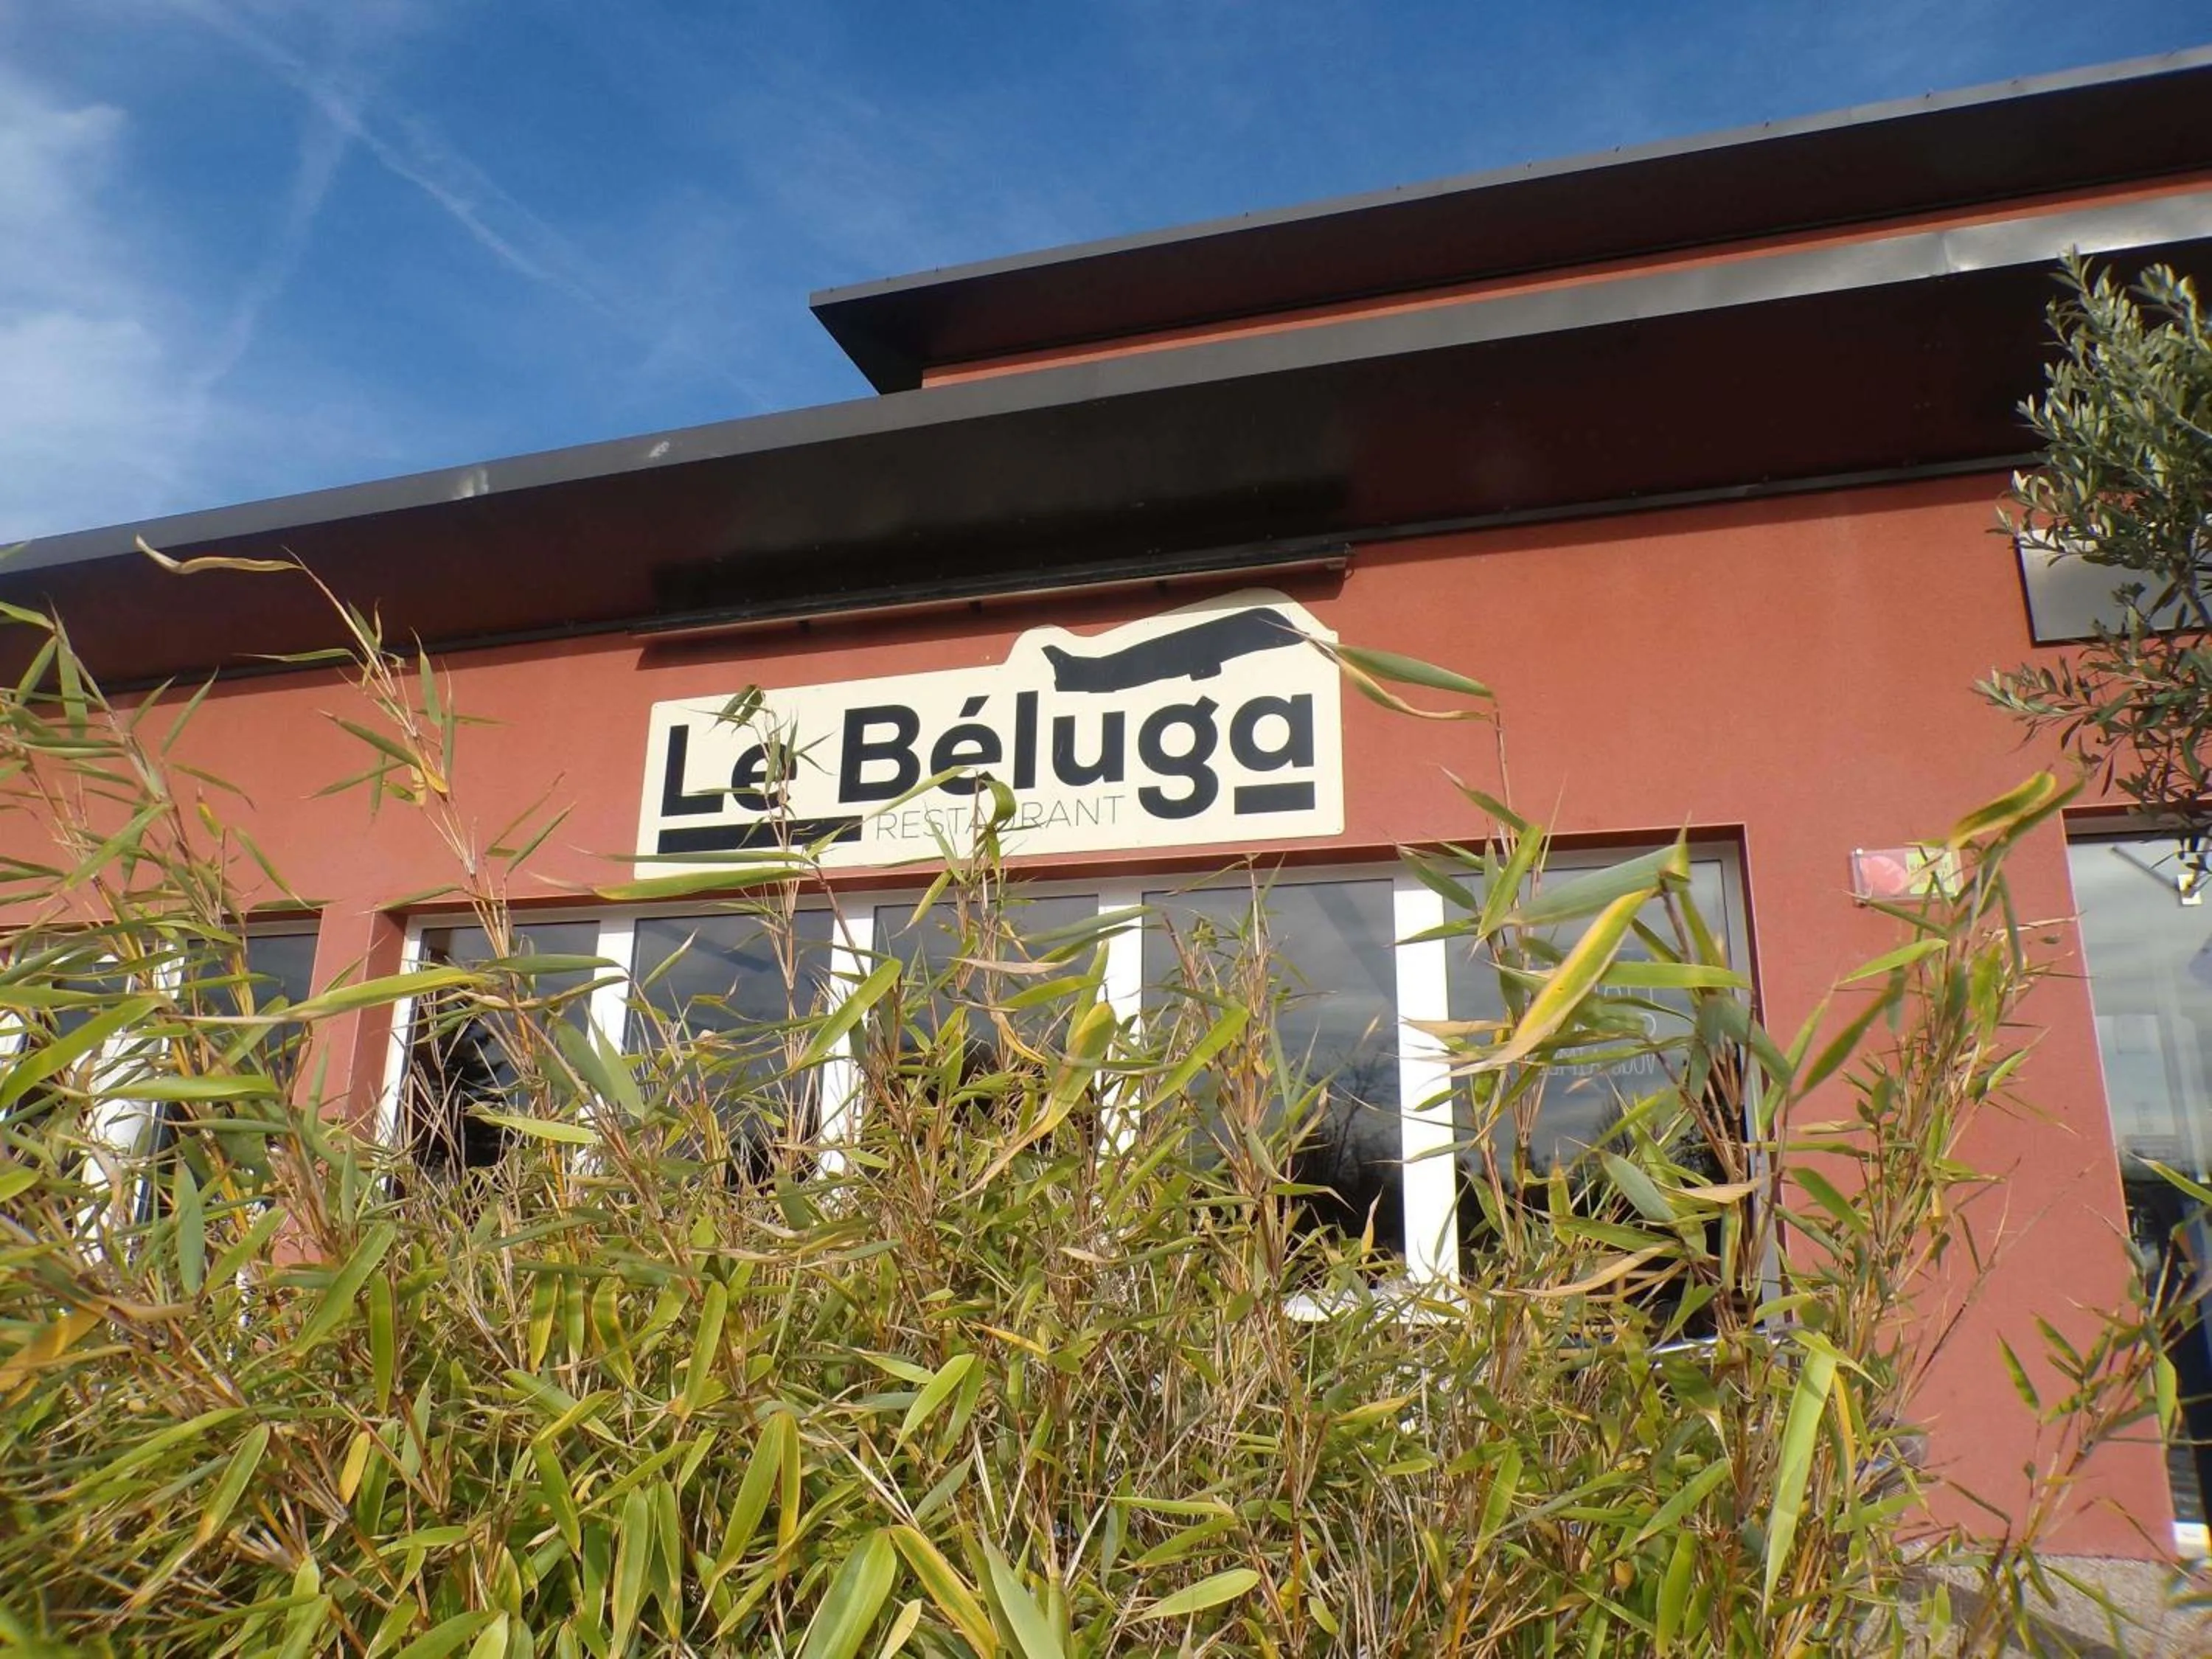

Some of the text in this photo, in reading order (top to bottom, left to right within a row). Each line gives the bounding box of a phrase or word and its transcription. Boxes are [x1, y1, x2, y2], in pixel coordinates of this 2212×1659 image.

[661, 690, 1315, 820] Le Béluga
[876, 795, 1125, 840] RESTARANT
